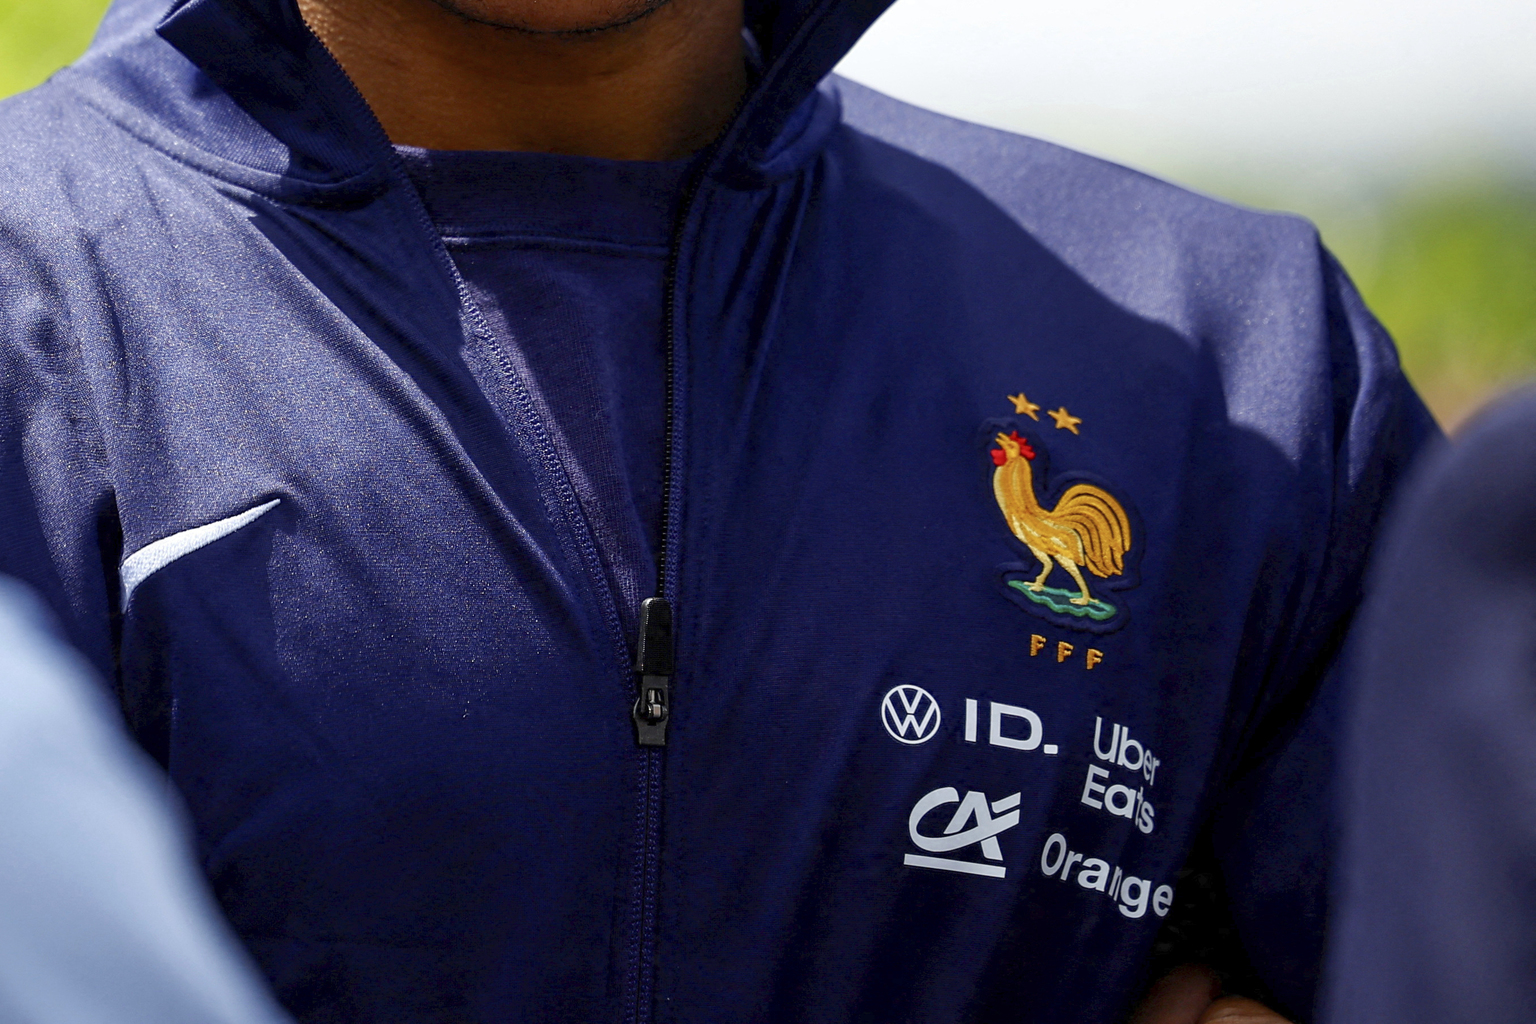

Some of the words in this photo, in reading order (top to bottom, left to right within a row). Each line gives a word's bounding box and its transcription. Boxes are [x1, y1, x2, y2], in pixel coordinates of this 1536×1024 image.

[965, 698, 1058, 755] ID.
[1093, 716, 1160, 786] Uber
[1081, 764, 1155, 834] Eats
[1041, 832, 1174, 918] Orange
